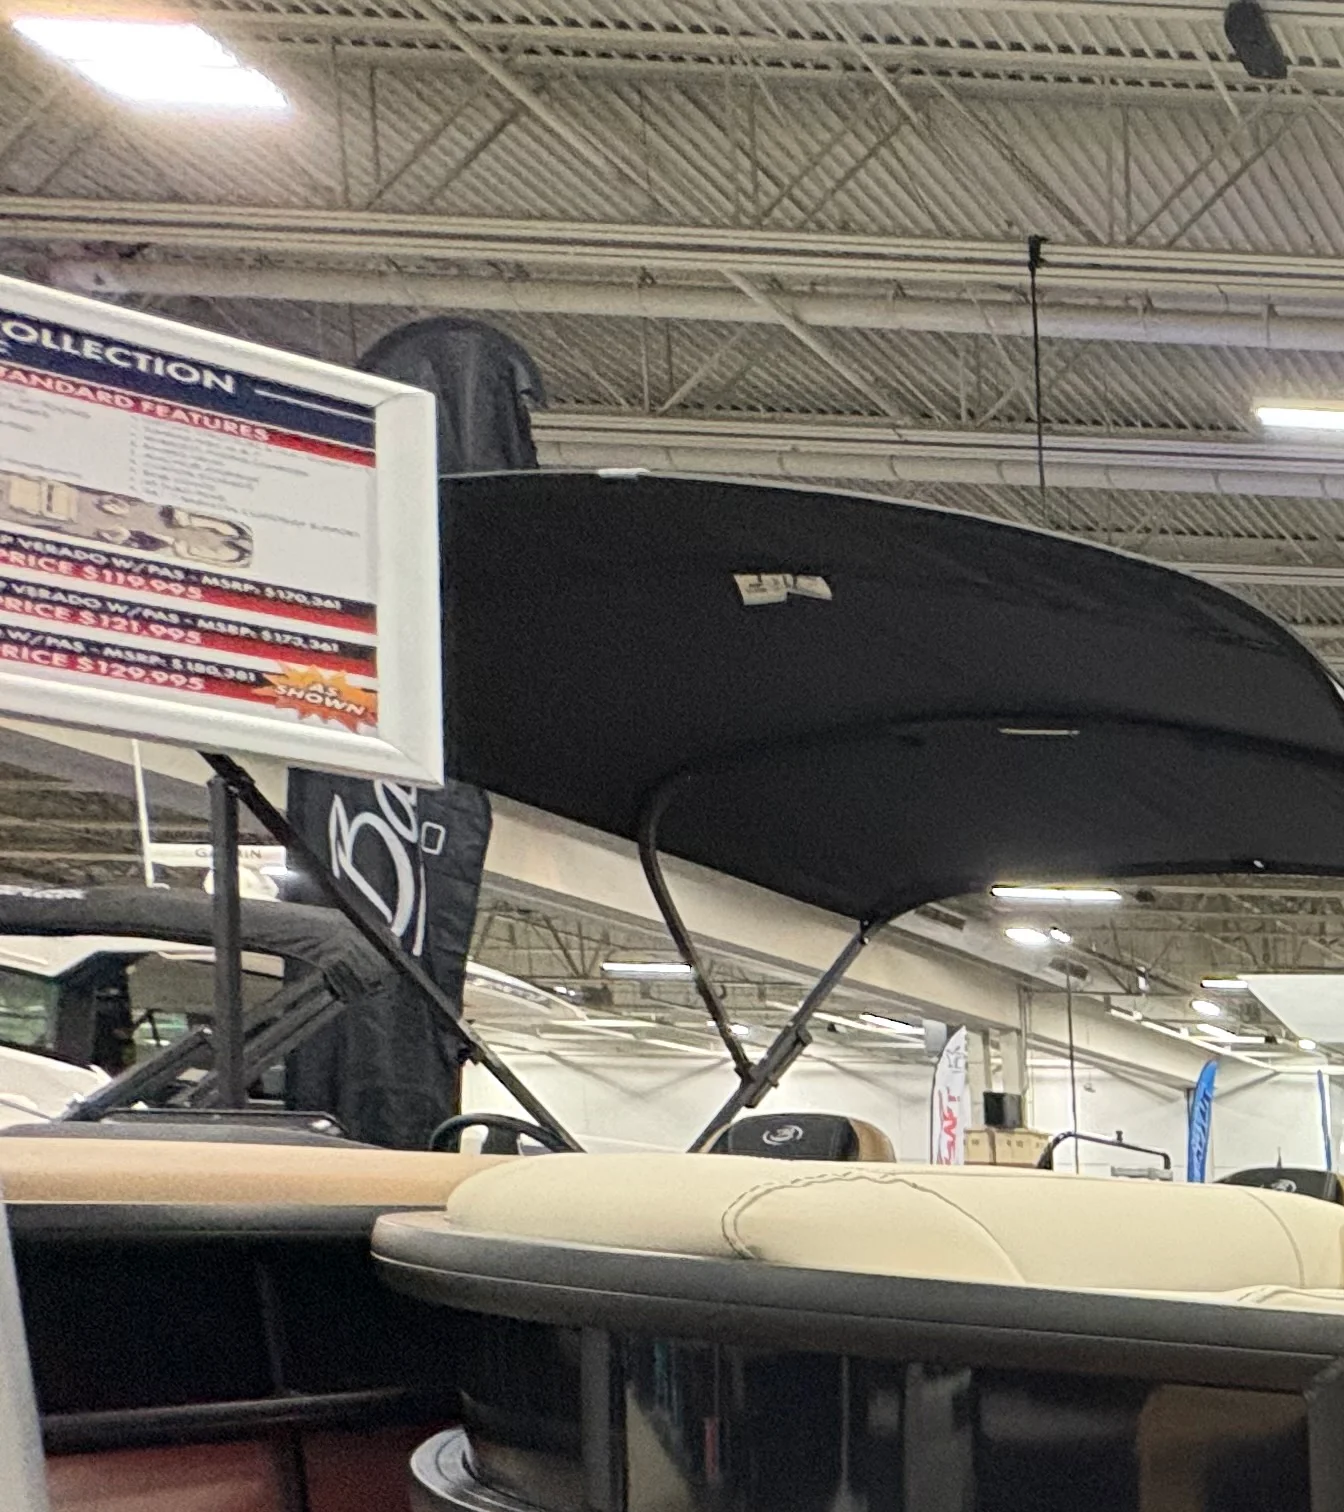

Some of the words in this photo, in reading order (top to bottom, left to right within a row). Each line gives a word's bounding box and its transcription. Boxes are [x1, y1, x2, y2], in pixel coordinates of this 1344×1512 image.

[1, 319, 236, 395] OLLECTION
[0, 366, 134, 409] TANDARD
[139, 401, 270, 441] FEATURES
[0, 643, 70, 667] RICE
[274, 684, 367, 716] SHOWN
[309, 683, 339, 698] AS
